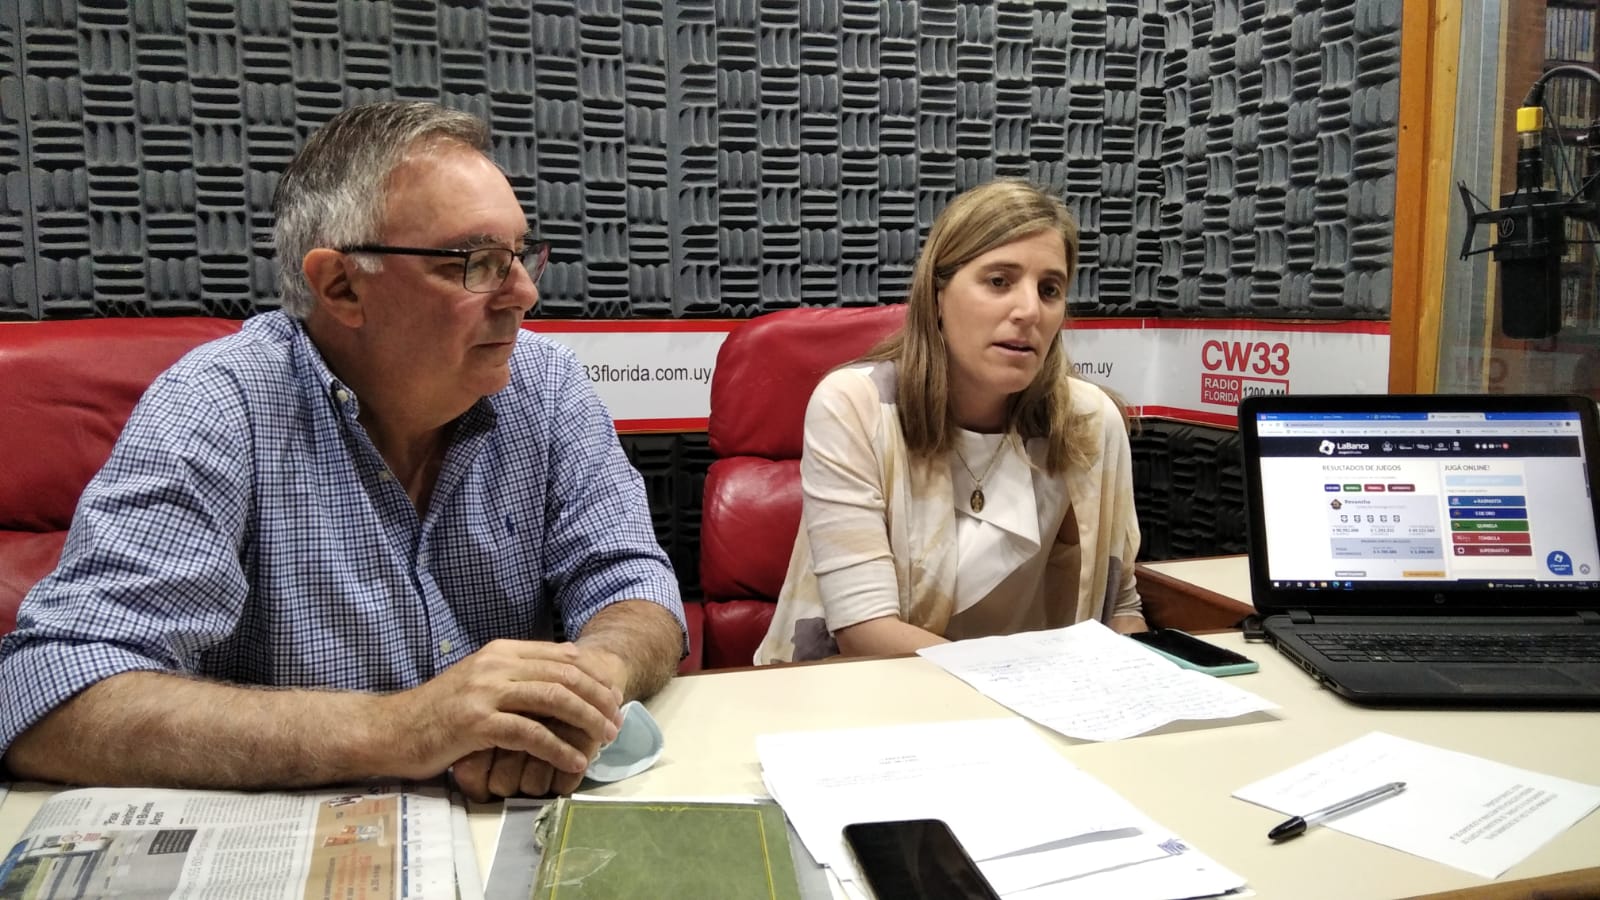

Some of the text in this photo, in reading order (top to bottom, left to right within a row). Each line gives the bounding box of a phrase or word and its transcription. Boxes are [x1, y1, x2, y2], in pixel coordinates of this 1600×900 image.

[1201, 340, 1290, 376] CW33
[1204, 378, 1239, 391] RADIO
[1204, 390, 1240, 404] FLORIDA
[1243, 387, 1266, 397] 1200
[1337, 441, 1370, 450] LaBanca
[1322, 464, 1402, 472] RESULTADOS DE JUEGOS
